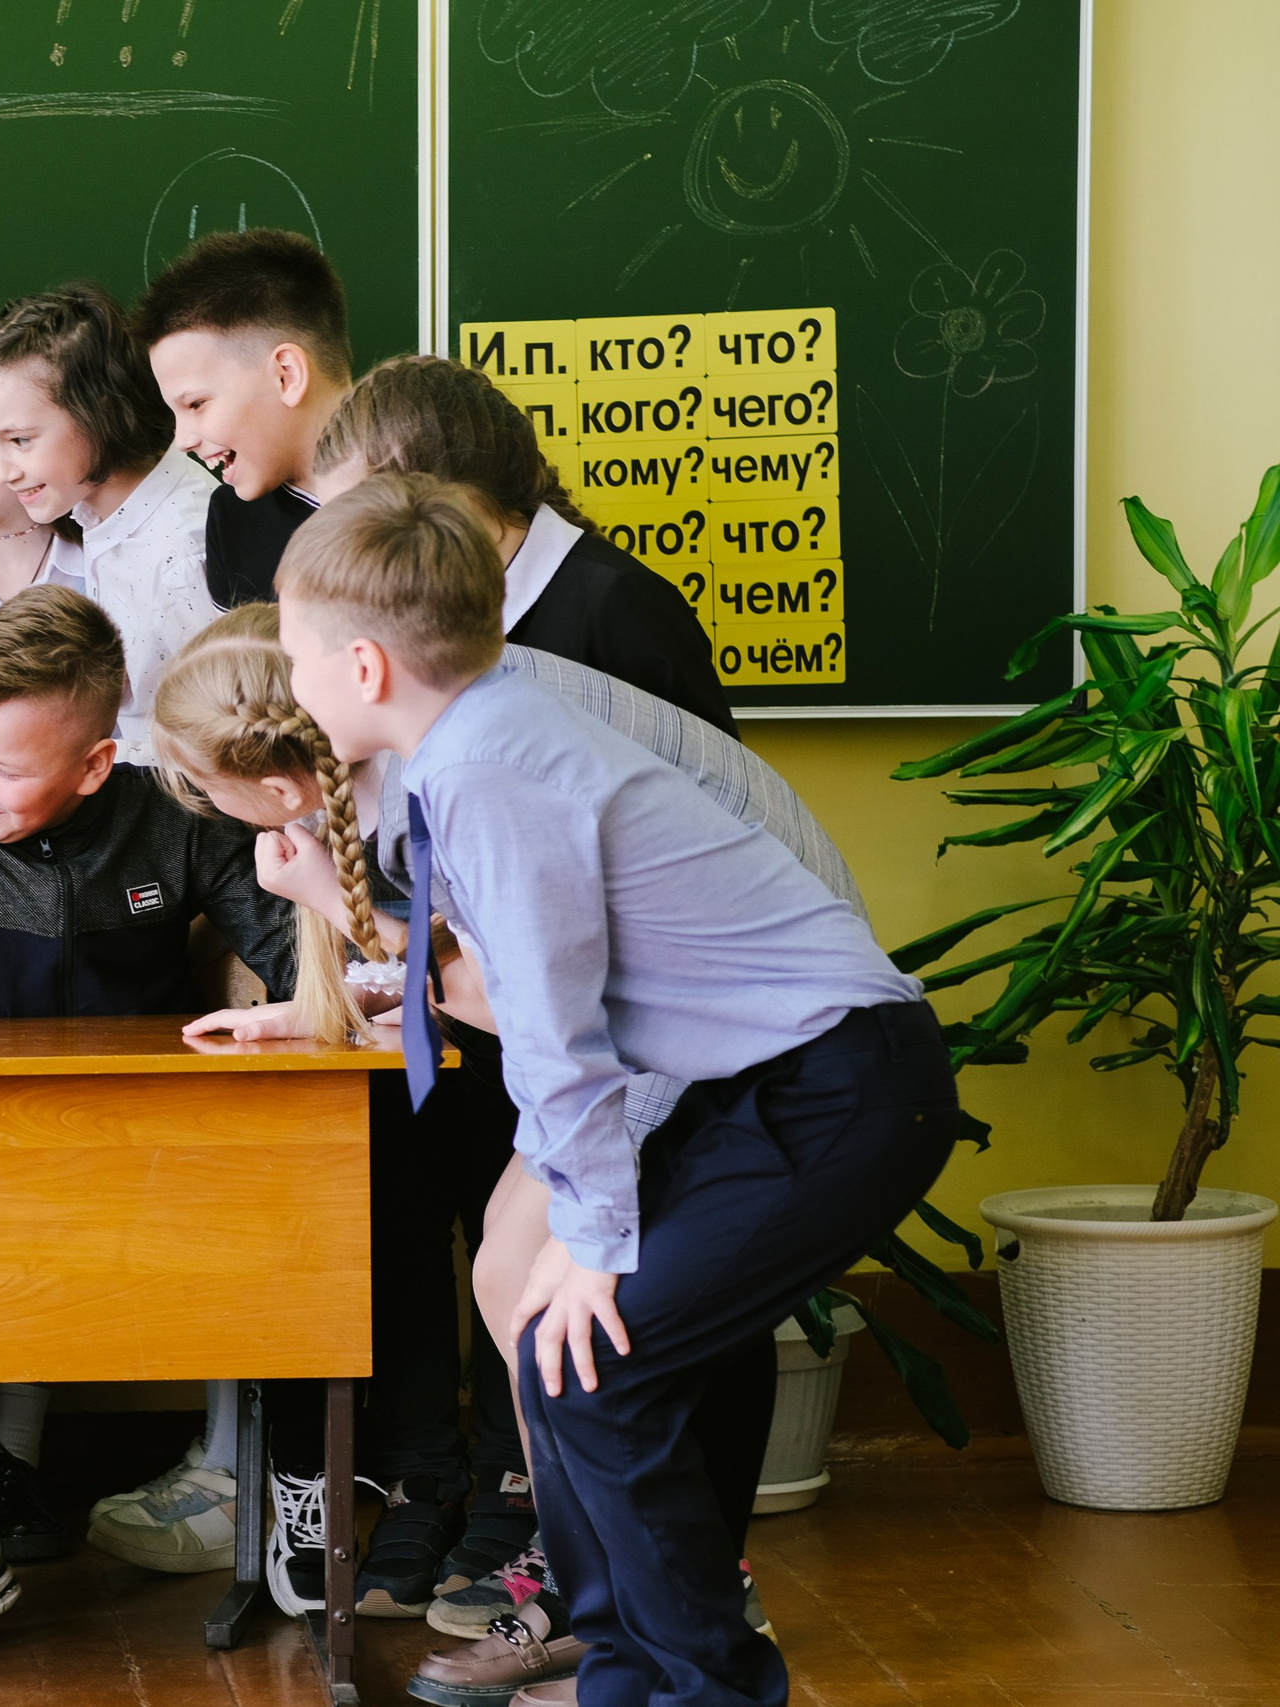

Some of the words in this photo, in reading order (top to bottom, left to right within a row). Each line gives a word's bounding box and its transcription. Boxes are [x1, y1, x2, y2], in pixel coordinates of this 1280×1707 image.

[469, 331, 567, 376] И.п.
[589, 324, 691, 371] кто?
[718, 318, 822, 366] что?
[582, 386, 703, 434] кого?
[713, 380, 834, 428] чего?
[583, 446, 705, 496] кому?
[711, 441, 835, 492] чему?
[600, 510, 706, 556] ого?
[723, 506, 826, 554] что?
[719, 568, 838, 615] чем?
[719, 644, 742, 675] о
[747, 632, 843, 675] чём?
[133, 897, 160, 909] CLASSIC
